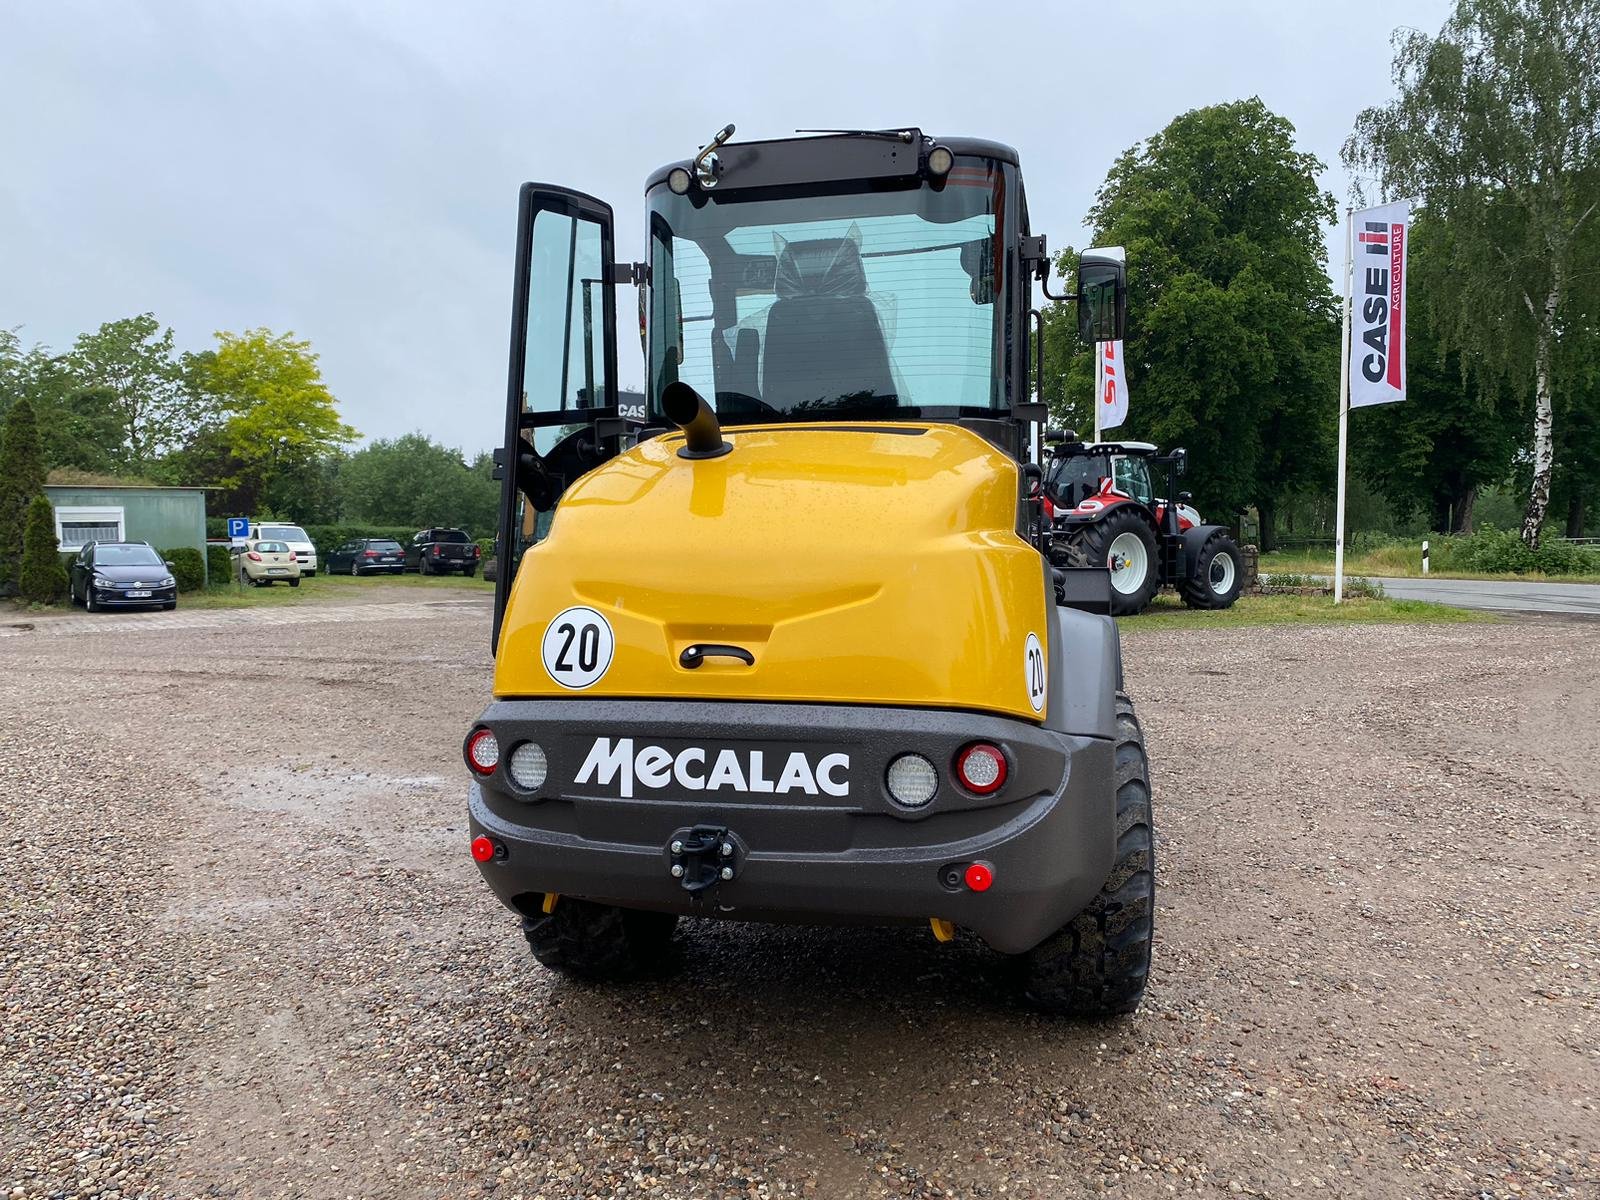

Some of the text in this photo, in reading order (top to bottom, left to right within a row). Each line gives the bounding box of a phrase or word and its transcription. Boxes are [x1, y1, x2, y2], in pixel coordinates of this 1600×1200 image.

[1391, 228, 1403, 311] AGRICULTURE
[1361, 267, 1389, 384] CASE
[232, 520, 244, 535] P
[554, 622, 600, 673] 20
[1028, 647, 1044, 698] 20
